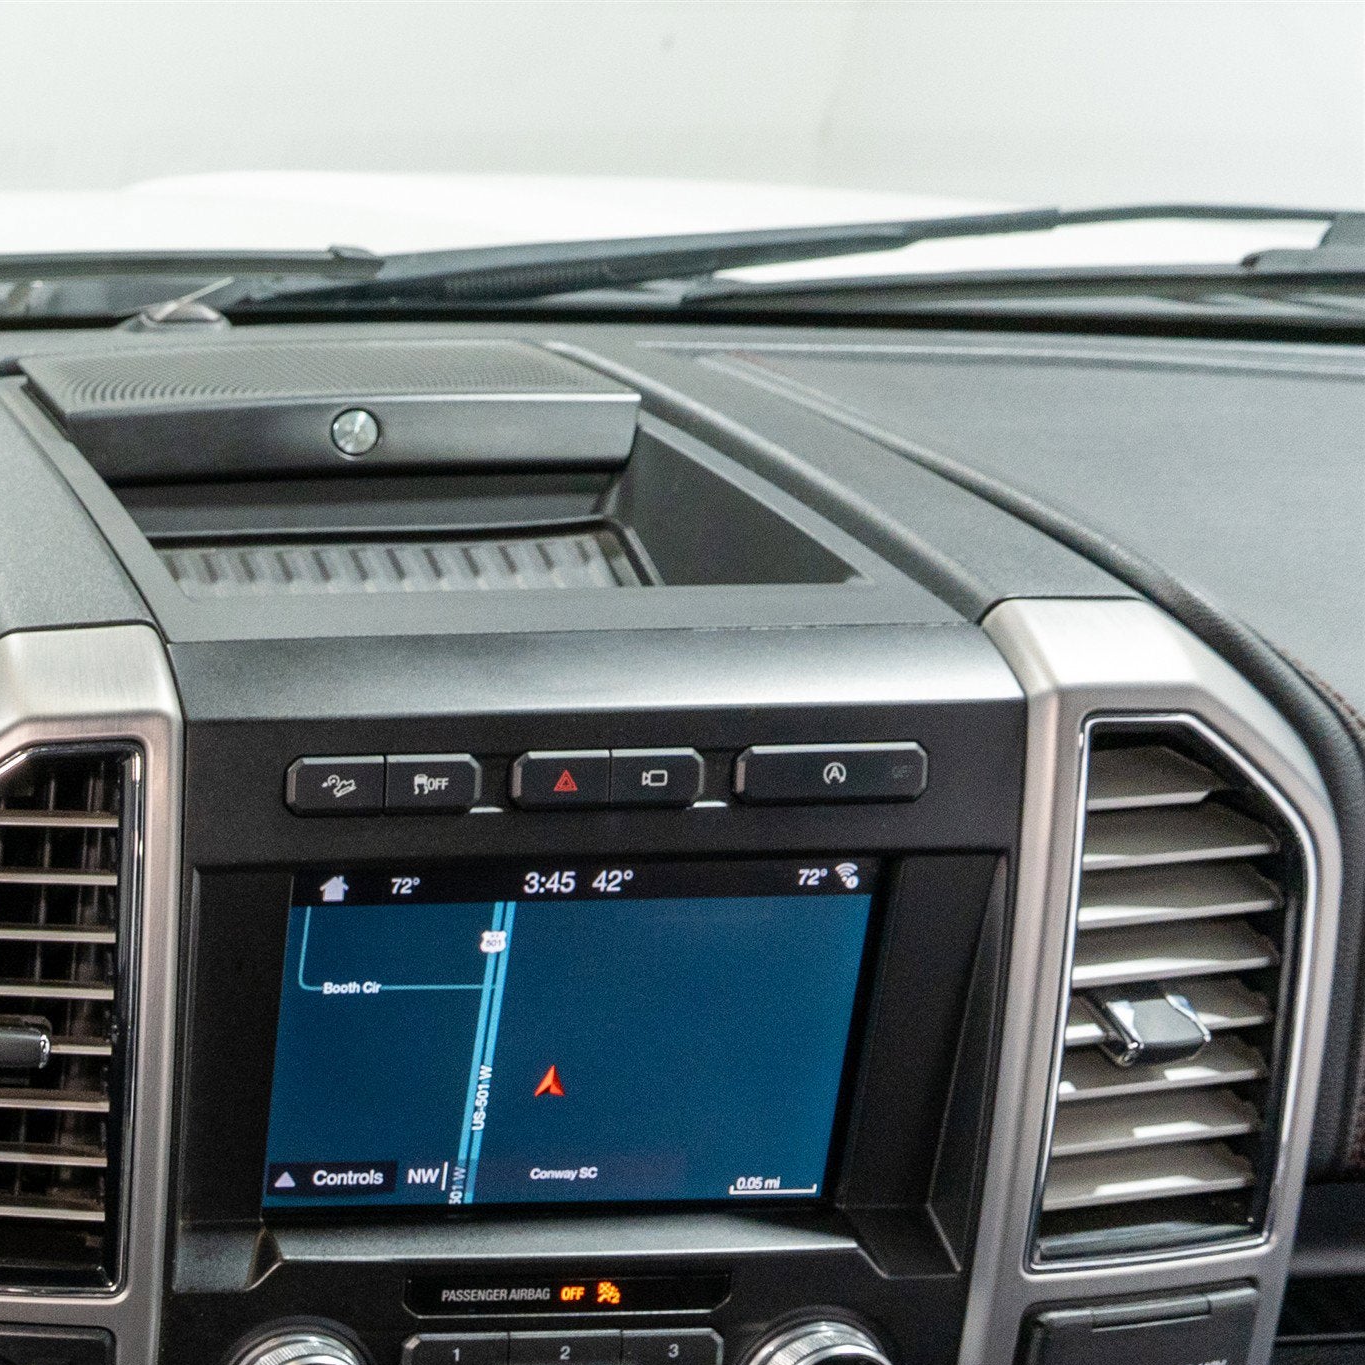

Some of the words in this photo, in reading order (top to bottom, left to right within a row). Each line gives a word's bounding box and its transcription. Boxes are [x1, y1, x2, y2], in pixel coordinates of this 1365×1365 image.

[427, 778, 449, 792] OFF
[523, 870, 576, 894] 3:45
[591, 870, 633, 892] 42°
[323, 982, 360, 994] Booth
[362, 981, 382, 993] Cir
[480, 1065, 492, 1080] W
[472, 1083, 490, 1131] US-501
[313, 1169, 384, 1186] Controls
[407, 1169, 439, 1184] NW
[452, 1167, 466, 1181] W
[530, 1168, 578, 1181] Conway
[579, 1167, 598, 1179] SC
[737, 1177, 762, 1190] 0.05
[764, 1177, 780, 1189] mi
[441, 1289, 507, 1301] PASSENGER
[509, 1288, 550, 1300] AIRBAG
[560, 1286, 585, 1301] OFF
[452, 1348, 460, 1362] 1
[560, 1346, 571, 1360] 2
[669, 1344, 680, 1358] 3
